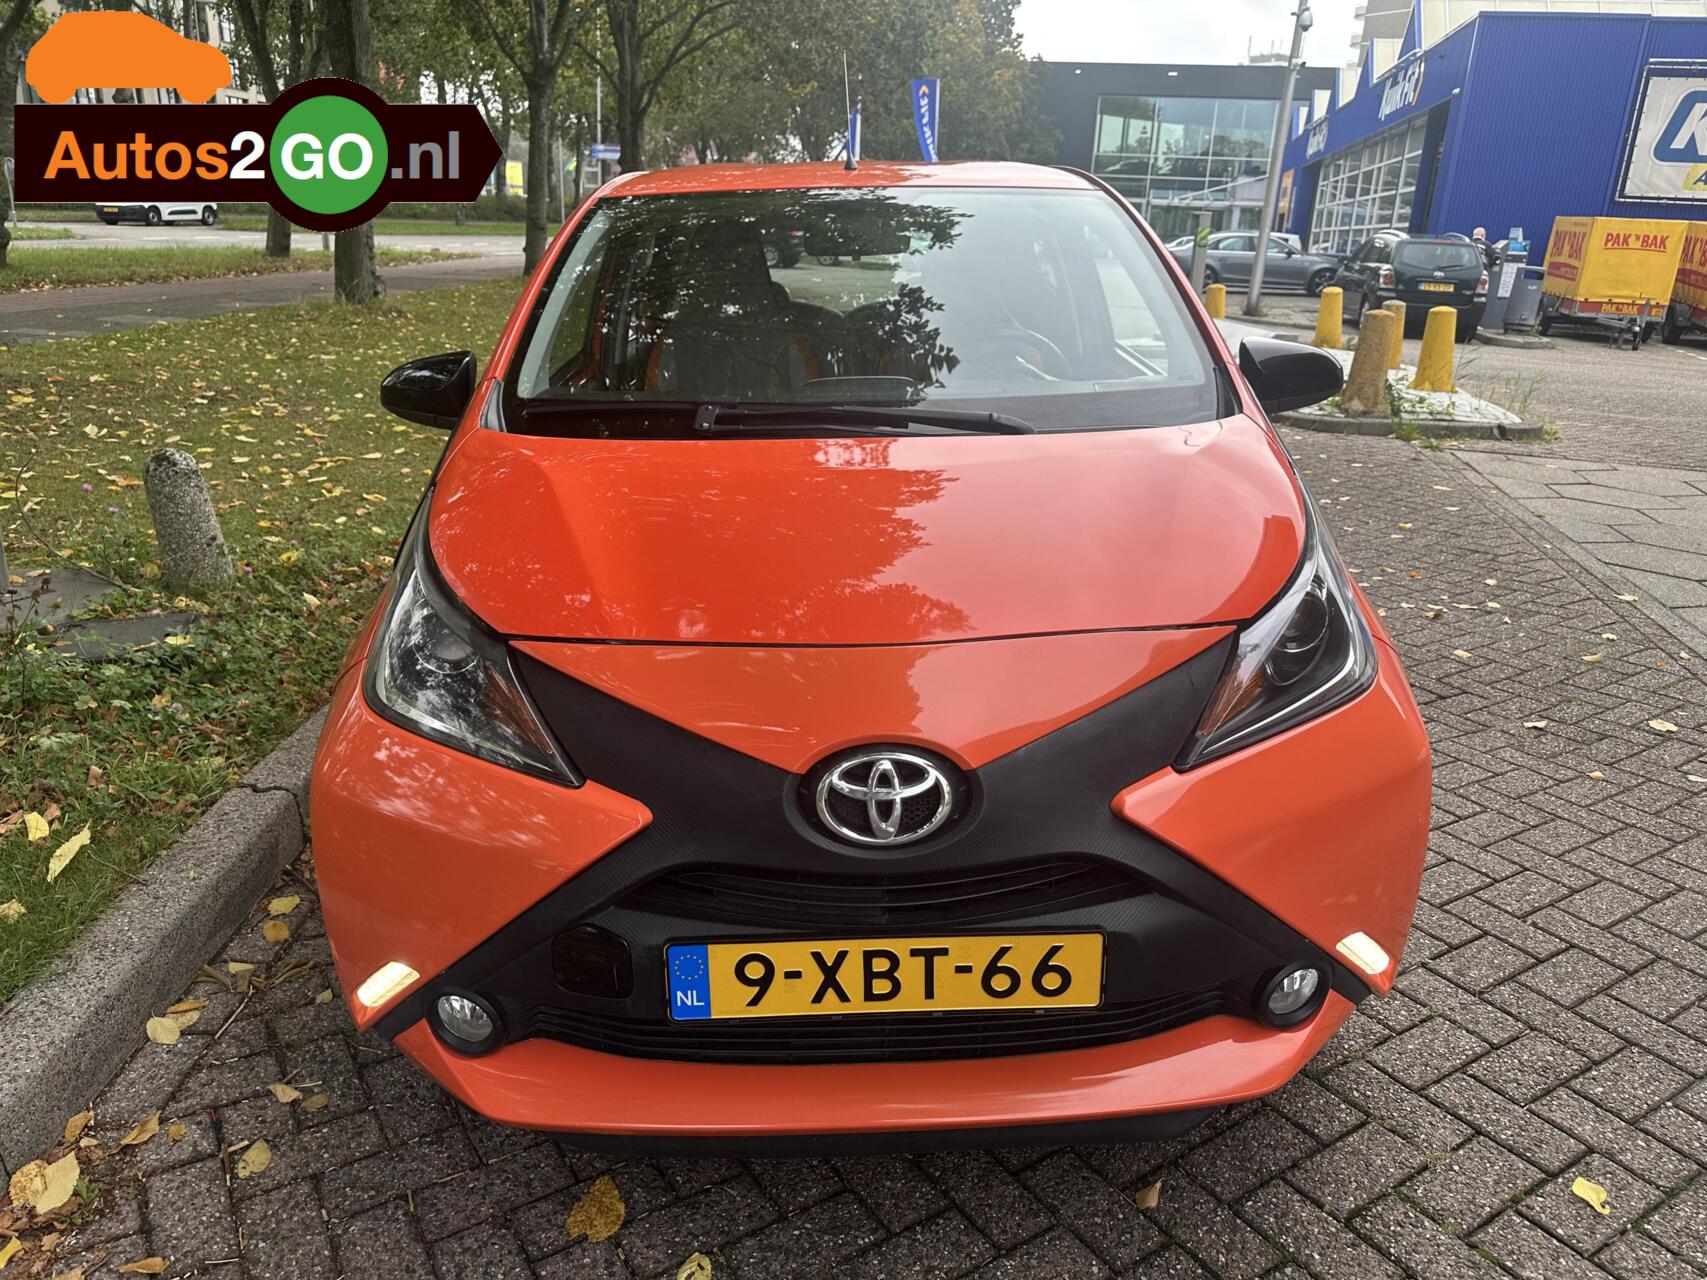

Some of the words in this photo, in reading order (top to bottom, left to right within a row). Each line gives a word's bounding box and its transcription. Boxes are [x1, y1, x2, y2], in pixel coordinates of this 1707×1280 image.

[1603, 232, 1632, 247] PAK
[1640, 234, 1670, 250] BAK
[1600, 303, 1618, 313] PAK
[1621, 304, 1640, 315] BAK
[733, 943, 1073, 1008] 9-XBT-66
[676, 990, 705, 1007] NL
